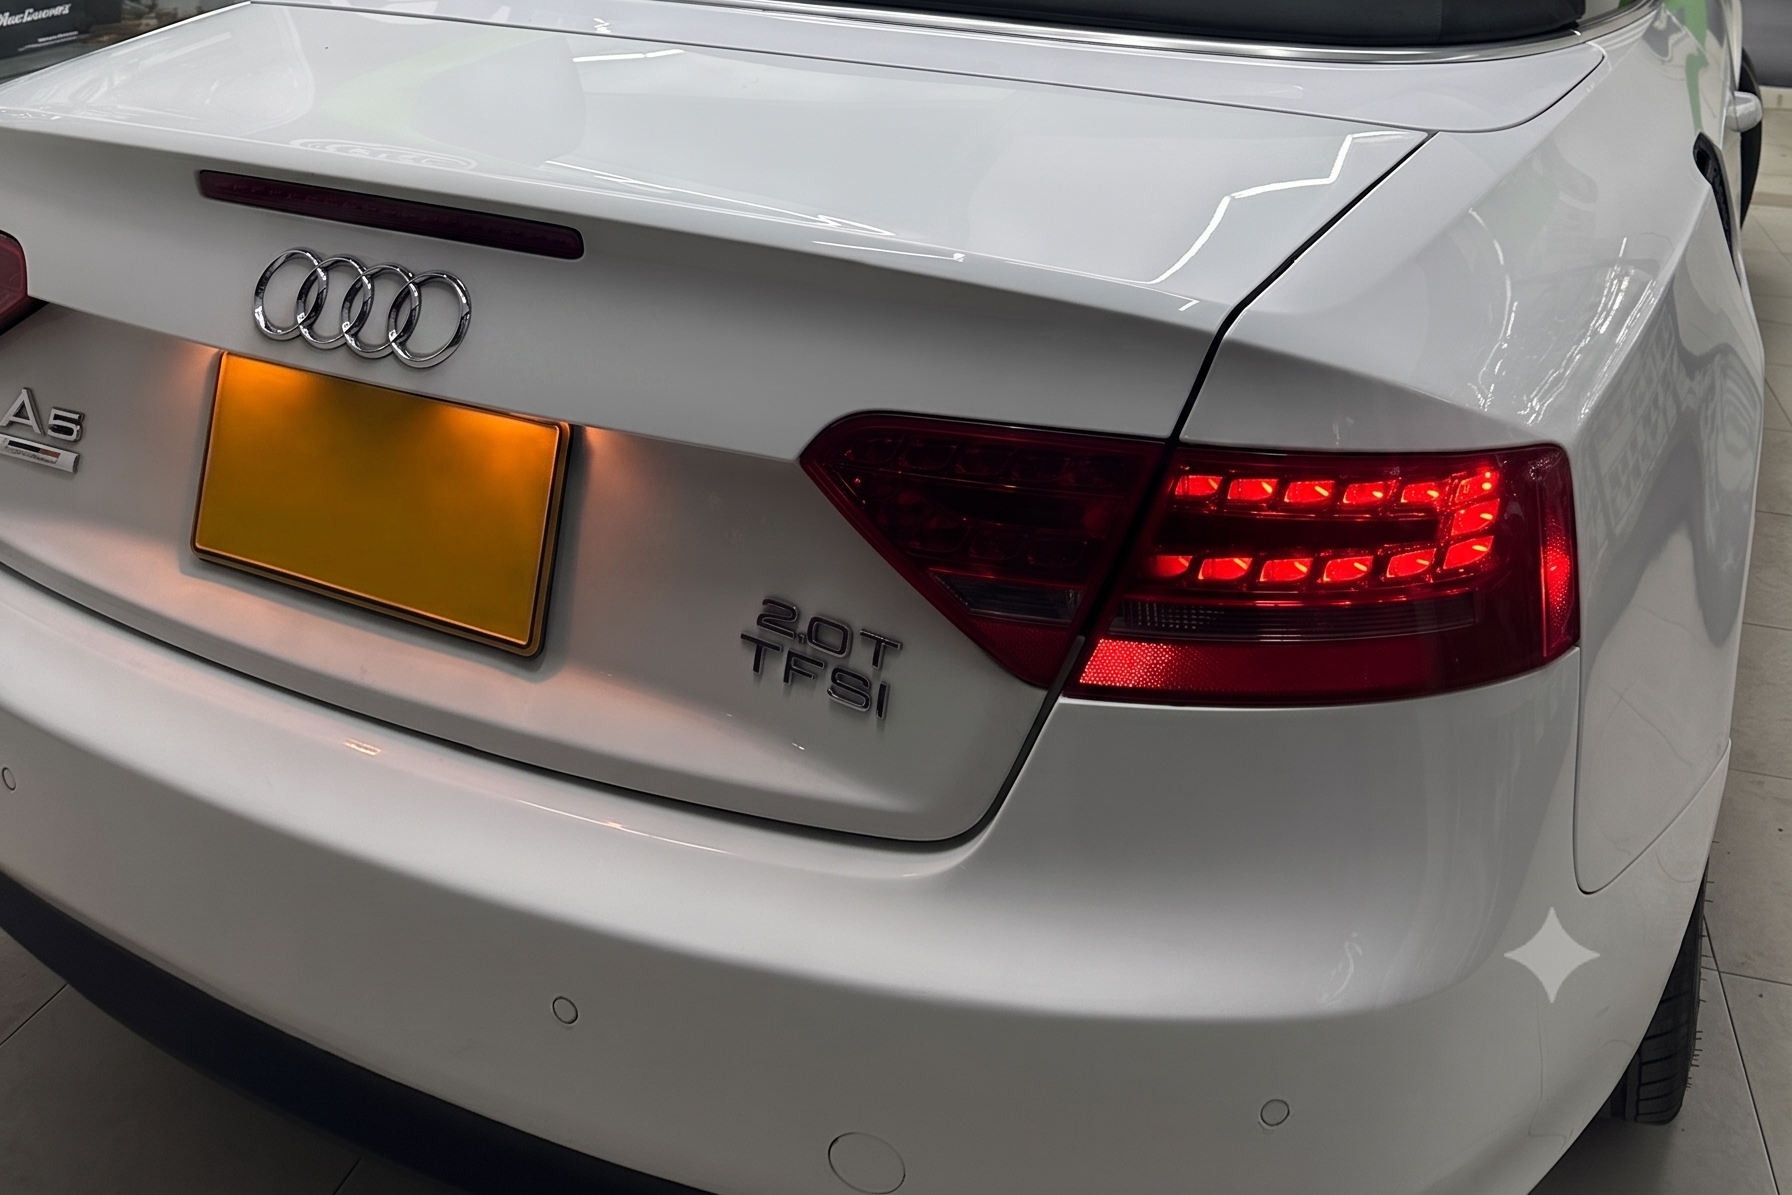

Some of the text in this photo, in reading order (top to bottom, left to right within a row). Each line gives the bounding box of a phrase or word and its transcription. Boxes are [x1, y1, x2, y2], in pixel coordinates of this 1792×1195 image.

[0, 387, 84, 442] A5
[756, 598, 903, 670] 2.0T
[740, 632, 888, 720] TFSI
